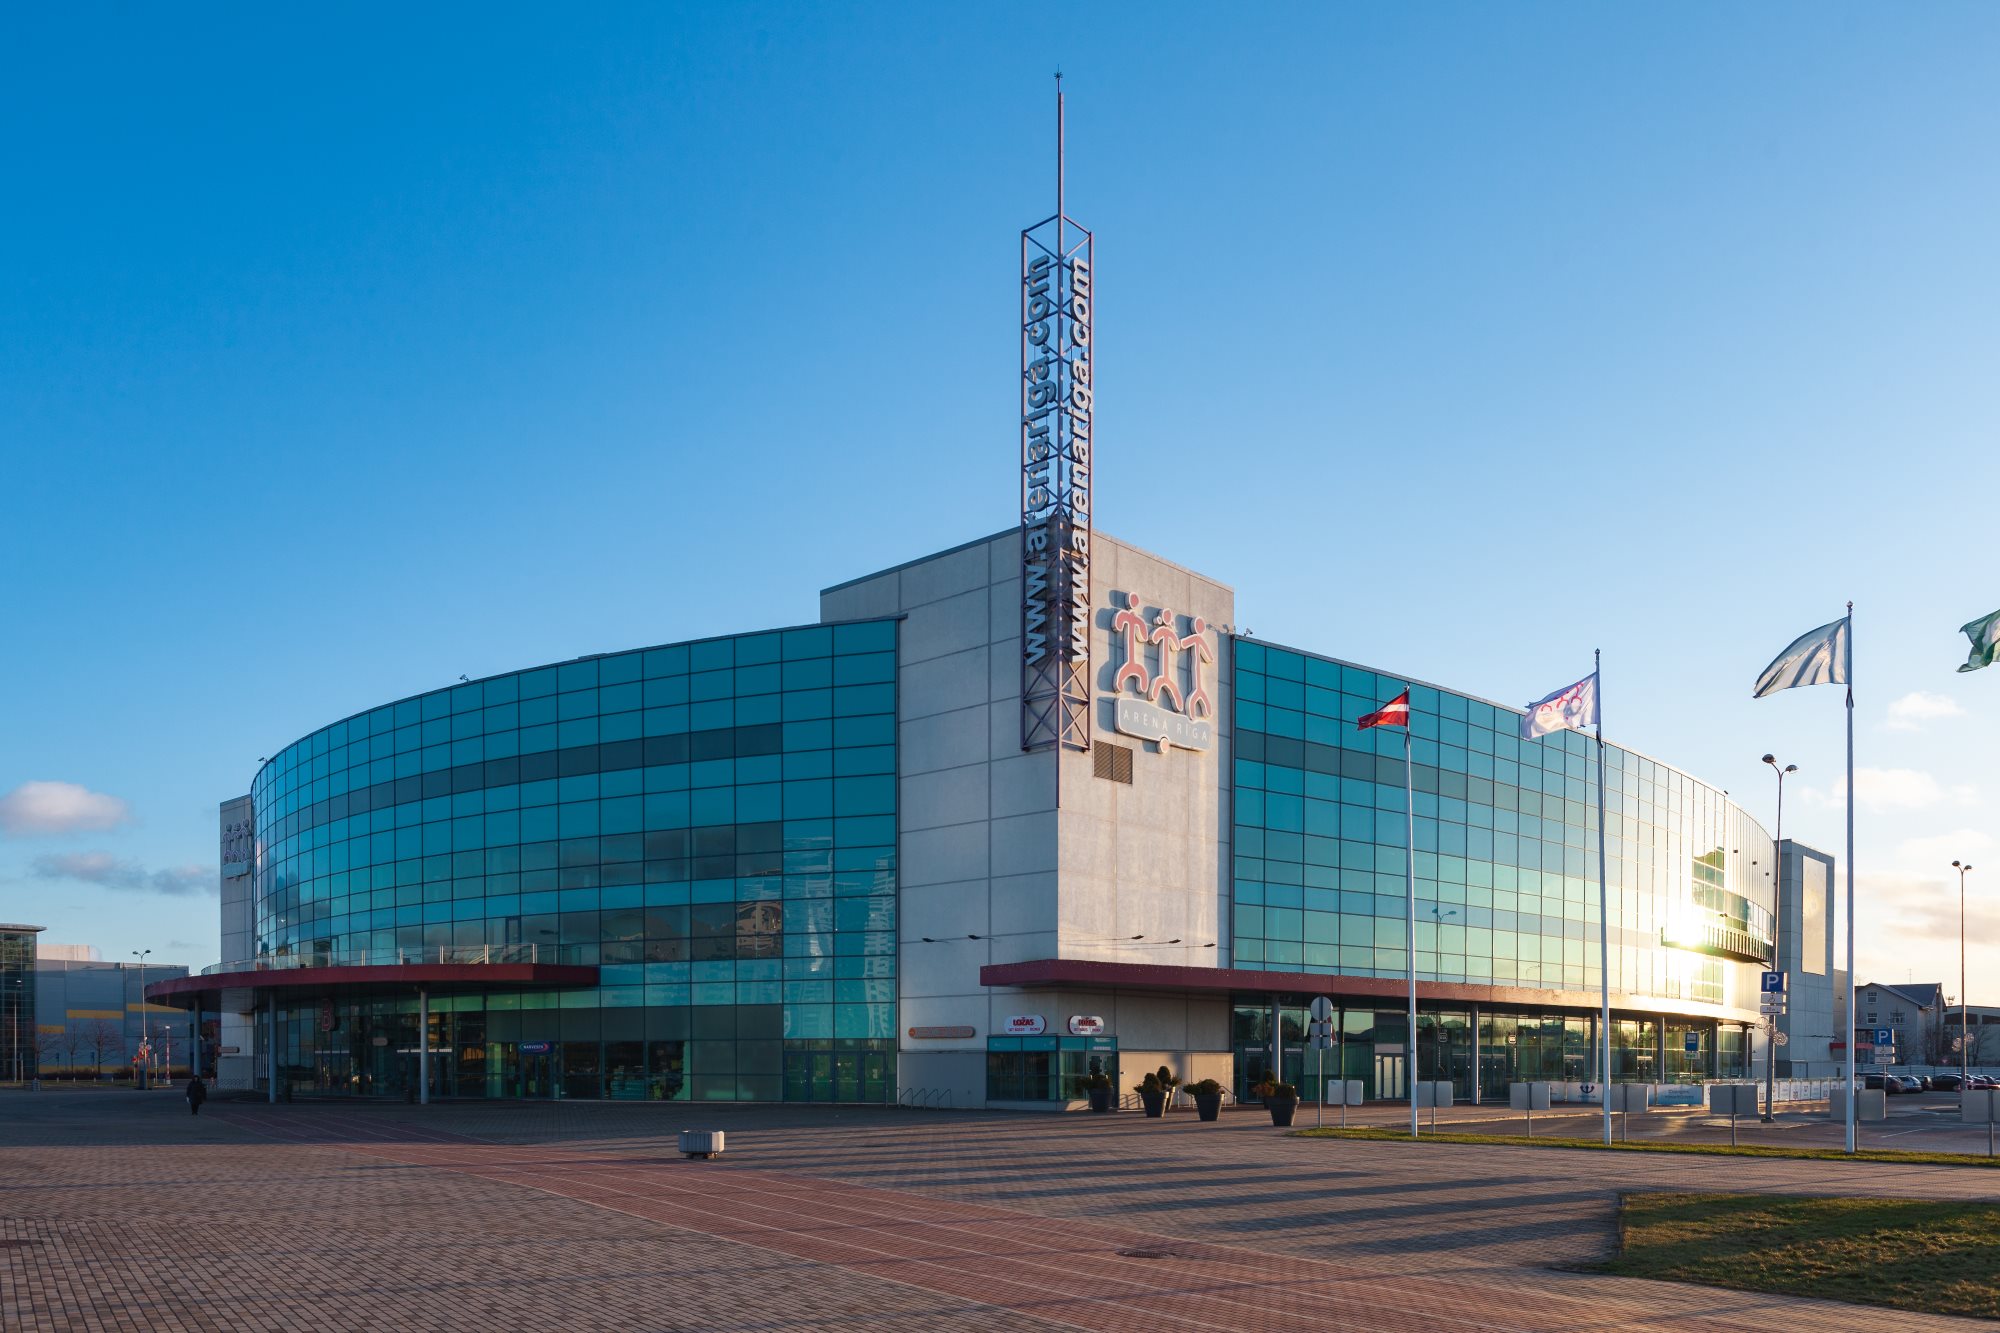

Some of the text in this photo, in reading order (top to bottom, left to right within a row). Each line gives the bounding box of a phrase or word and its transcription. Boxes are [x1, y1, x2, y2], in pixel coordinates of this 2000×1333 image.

[1023, 255, 1056, 666] www.arenariga.com
[1065, 256, 1093, 663] www.arenariga.com
[1766, 974, 1779, 990] P
[1878, 1030, 1889, 1043] P
